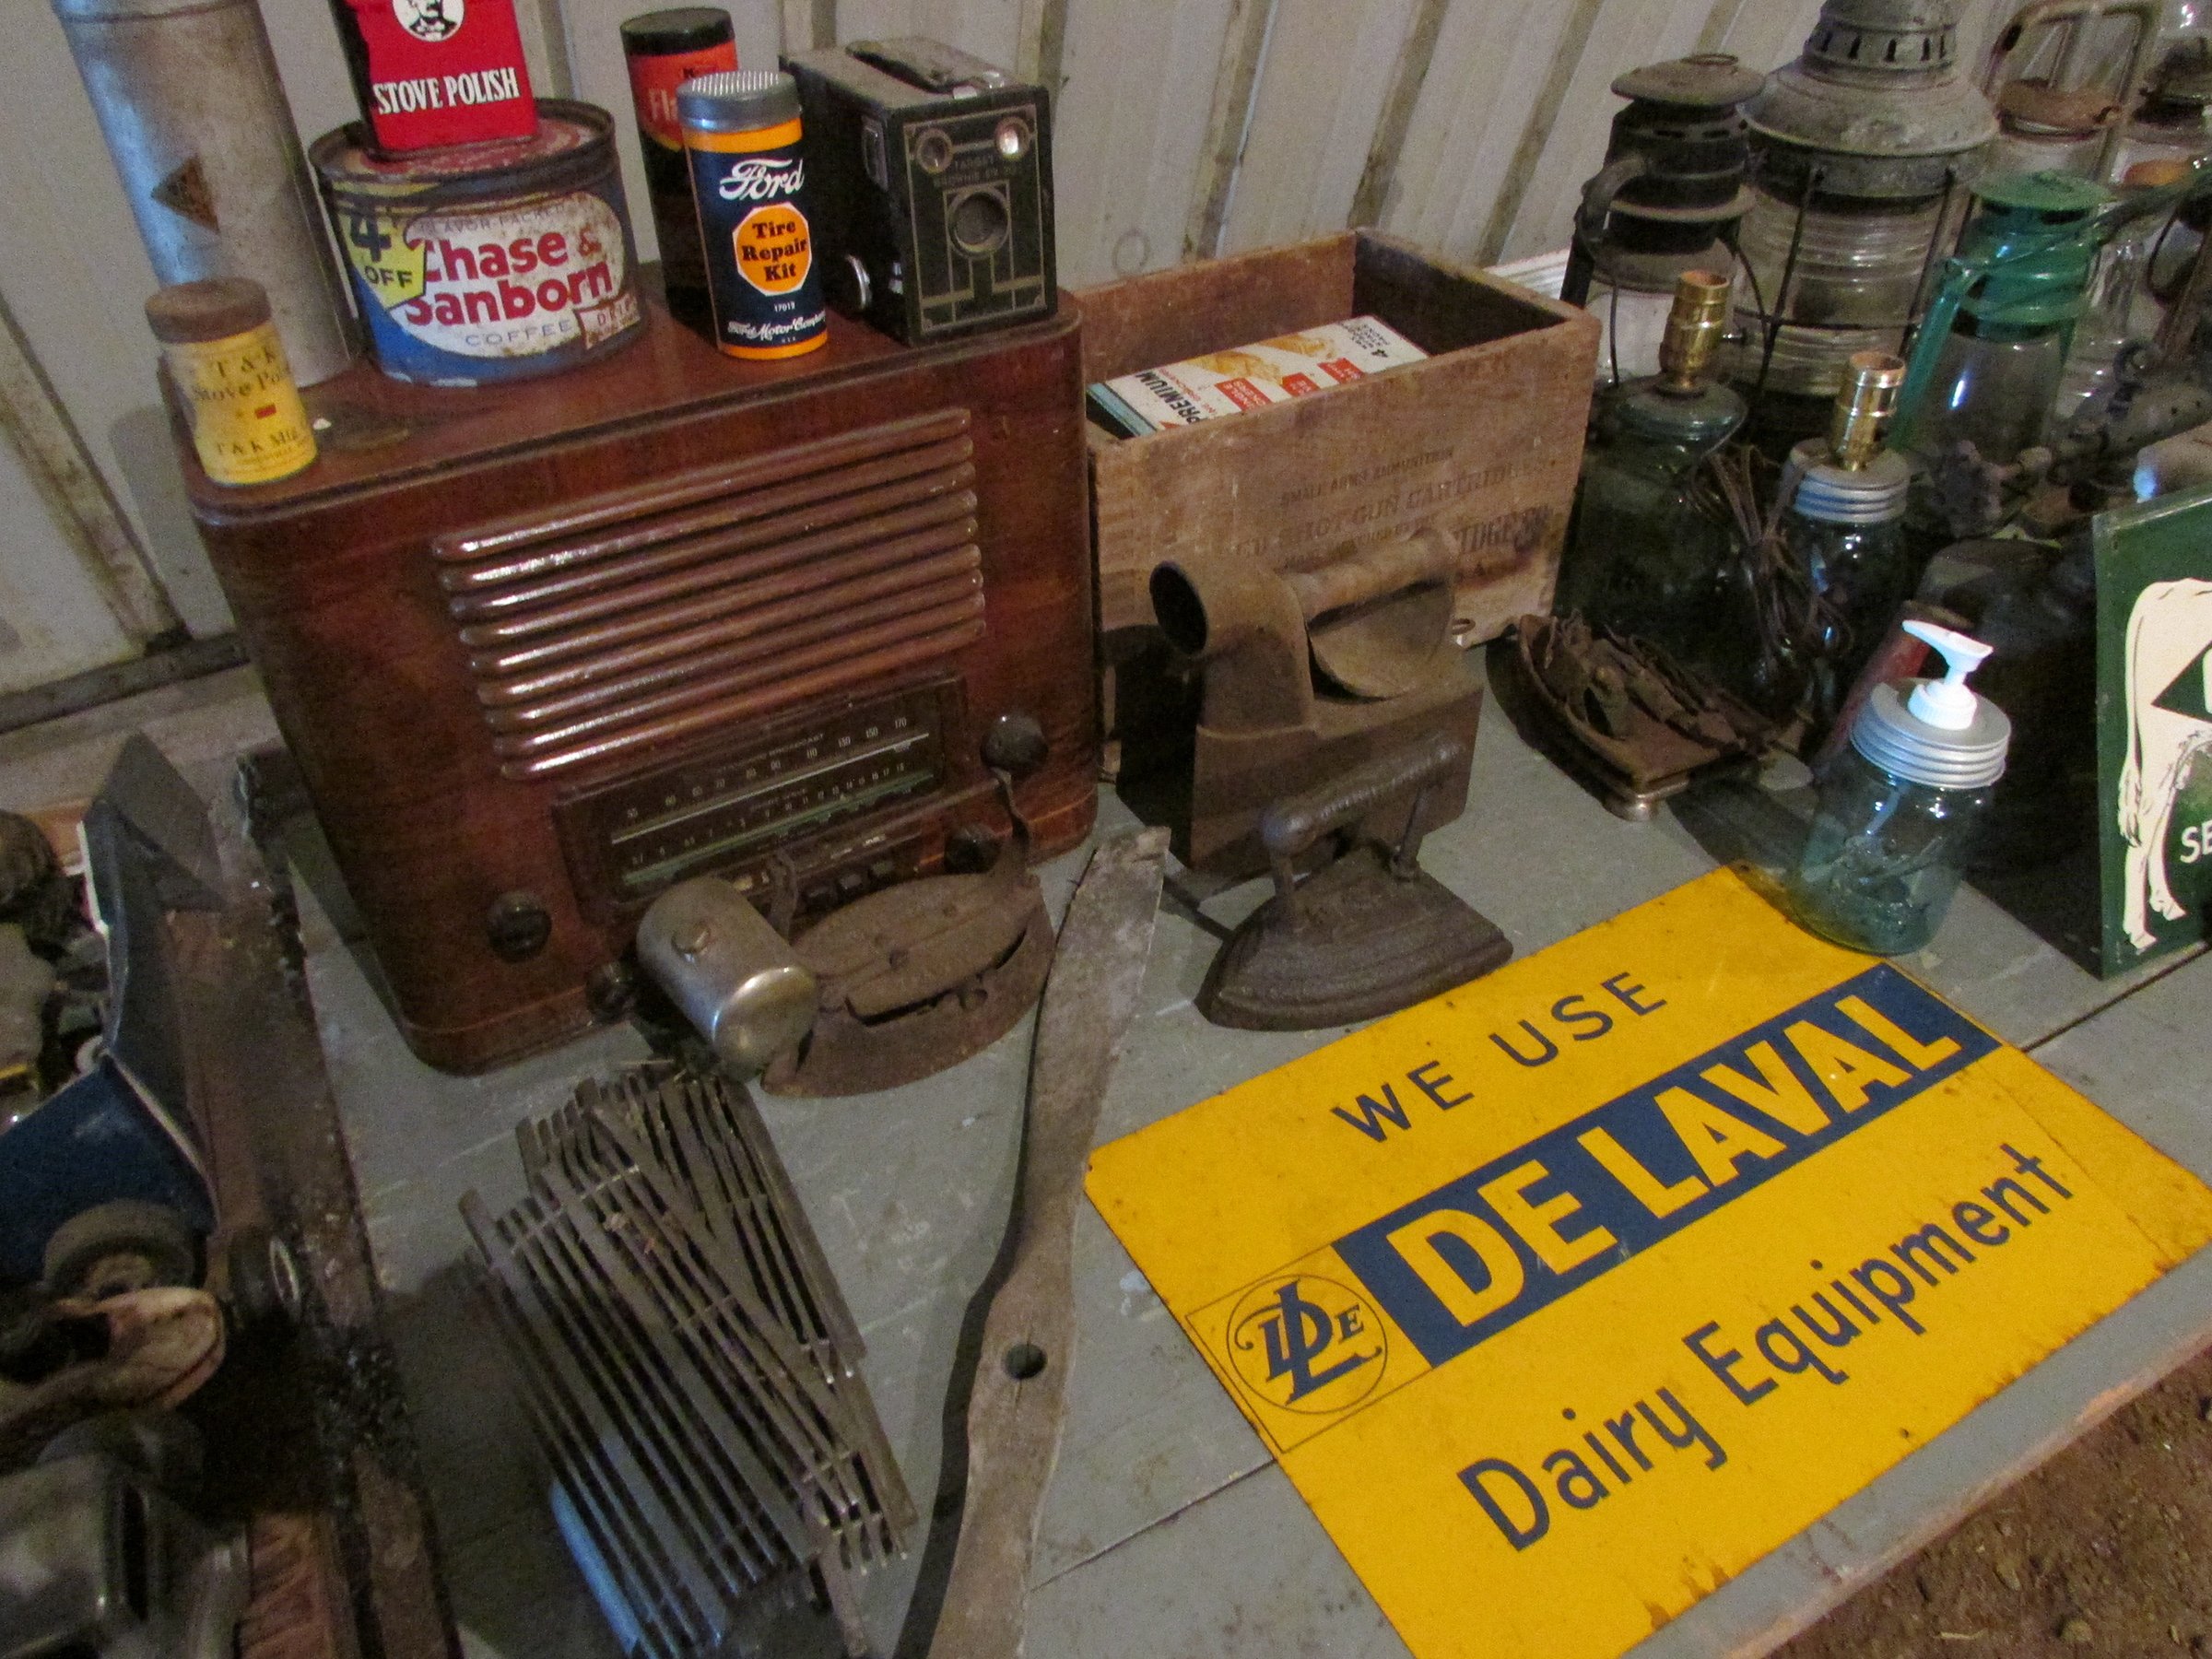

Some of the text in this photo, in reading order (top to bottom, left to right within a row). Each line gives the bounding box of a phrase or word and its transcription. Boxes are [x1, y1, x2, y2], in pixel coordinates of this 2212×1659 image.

[372, 67, 520, 114] STOVE POLISH
[719, 158, 805, 200] Ford
[741, 237, 808, 262] Repair
[752, 220, 796, 240] Tire
[406, 224, 602, 282] Chase &
[764, 263, 796, 282] Kit
[364, 265, 413, 288] OFF
[406, 261, 613, 326] Sanborn
[465, 319, 574, 347] COFFEE
[757, 319, 793, 342] Motor
[1135, 371, 1205, 424] PREMIUM
[894, 717, 907, 729] 170
[1331, 971, 1667, 1144] WE USE
[1386, 994, 1963, 1328] DE LAVAL
[1456, 1142, 2075, 1551] Dairy Equipment
